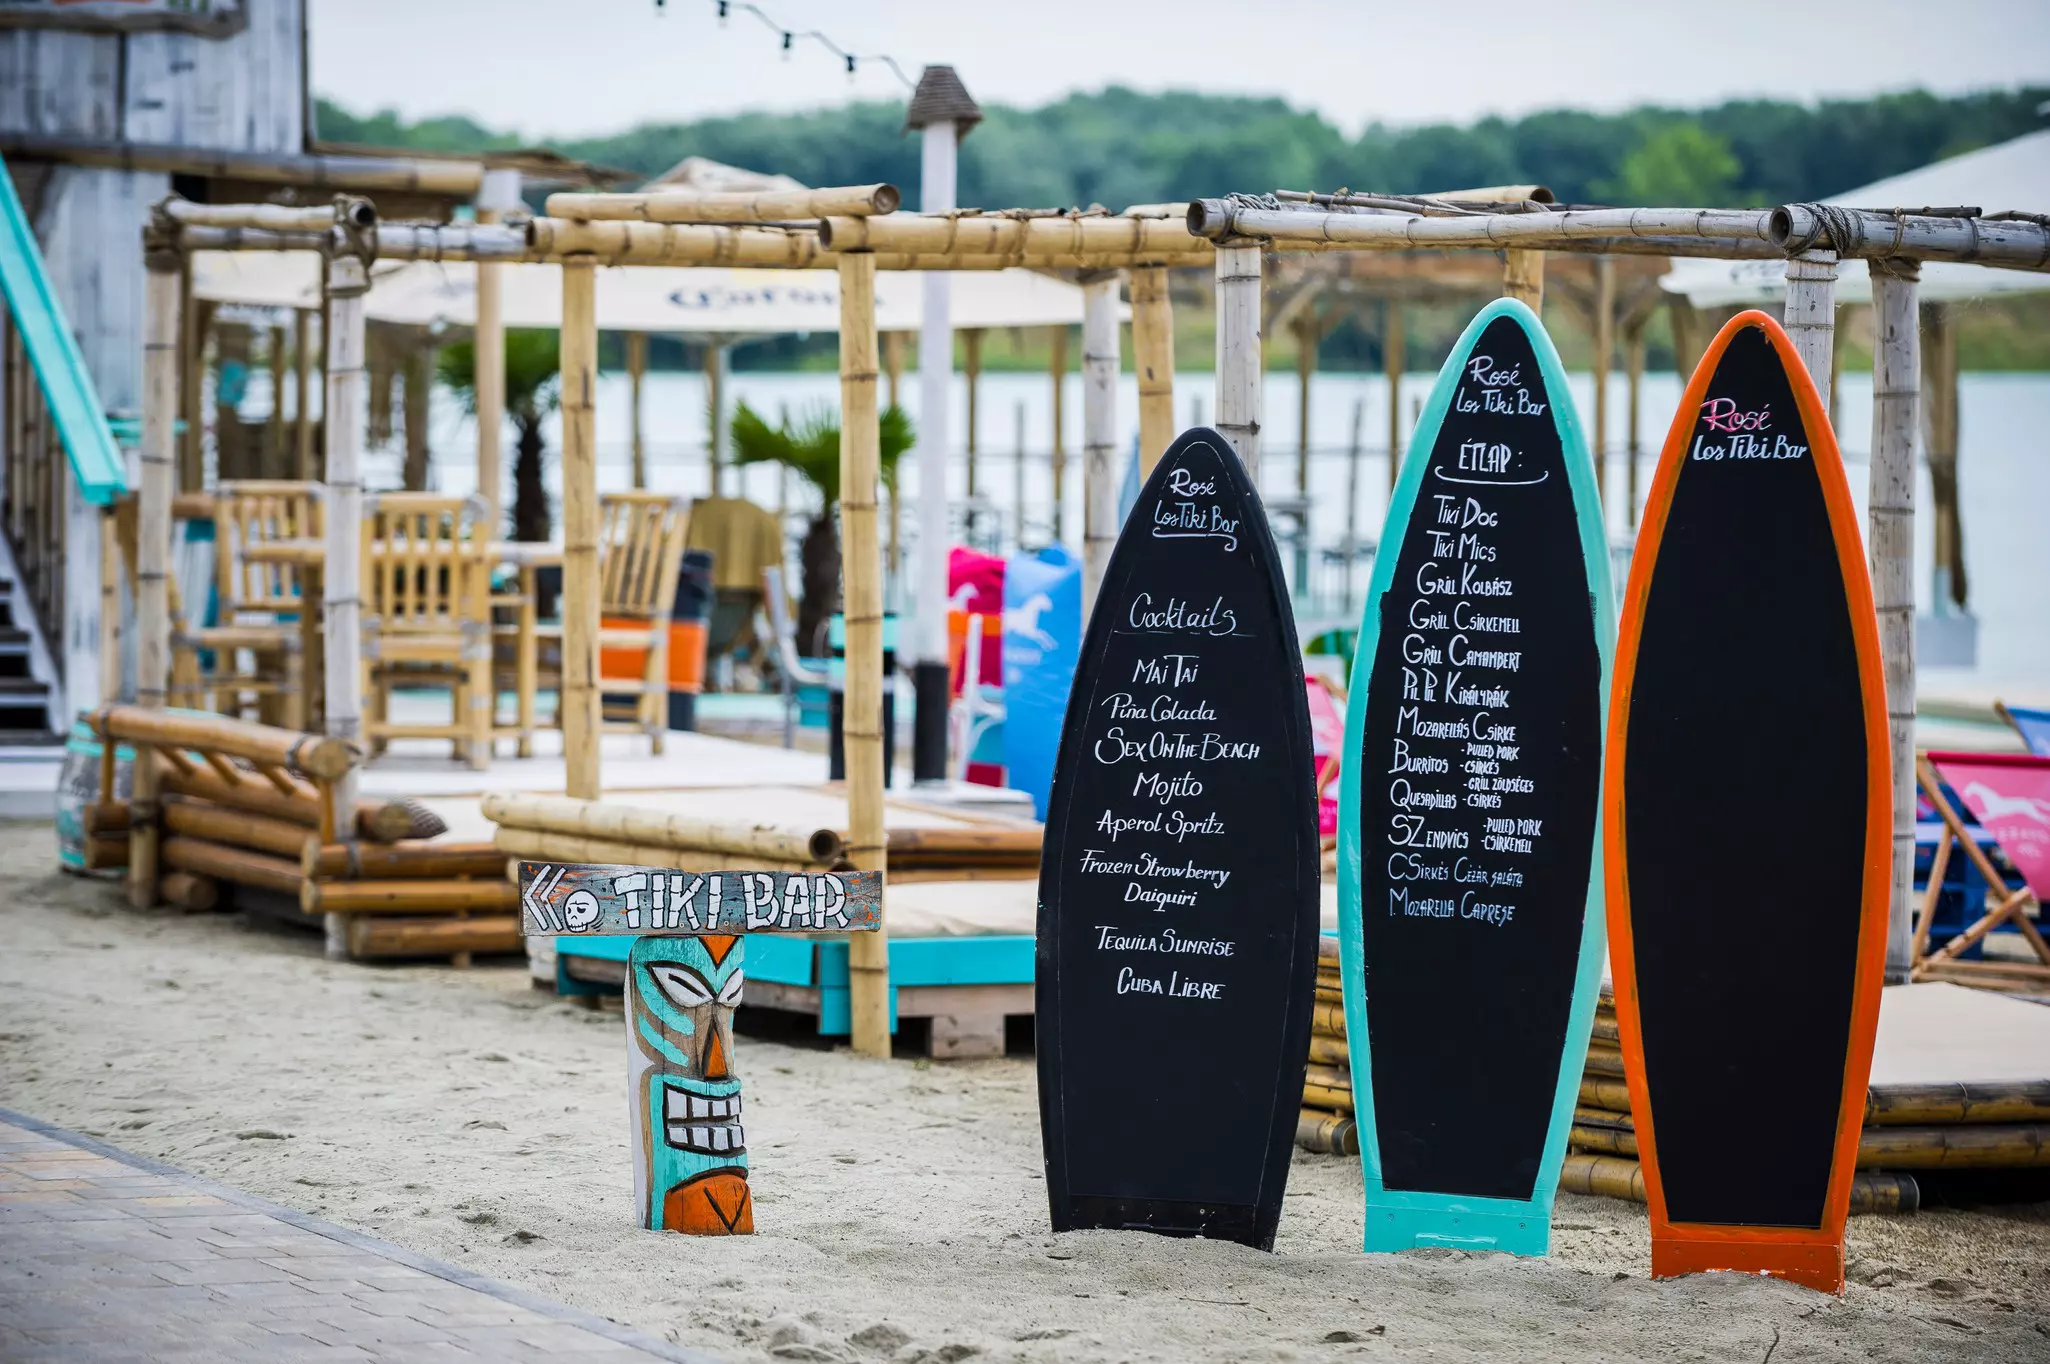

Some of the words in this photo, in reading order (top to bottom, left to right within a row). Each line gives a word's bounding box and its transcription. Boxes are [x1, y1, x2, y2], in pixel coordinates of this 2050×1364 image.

[1468, 355, 1521, 386] Rosé
[1456, 387, 1480, 413] Los
[1481, 389, 1514, 414] Tiki
[1517, 388, 1547, 416] Bar
[1700, 398, 1772, 432] Rosé
[1693, 435, 1726, 461] Los
[1727, 434, 1772, 459] Tiki
[1773, 434, 1807, 460] Bar
[1170, 468, 1216, 497] Rosé
[1210, 505, 1240, 533] Bar
[1129, 592, 1236, 636] Cocktails
[1101, 693, 1148, 719] Piña
[1150, 695, 1217, 722] Colada
[1132, 771, 1203, 805] Mojito
[1096, 809, 1162, 842] Aperol
[1166, 811, 1225, 843] Spritz
[1080, 849, 1133, 874] Frozen
[613, 873, 724, 931] TIKI
[741, 873, 849, 931] BAR
[1123, 882, 1198, 912] Daiquiri
